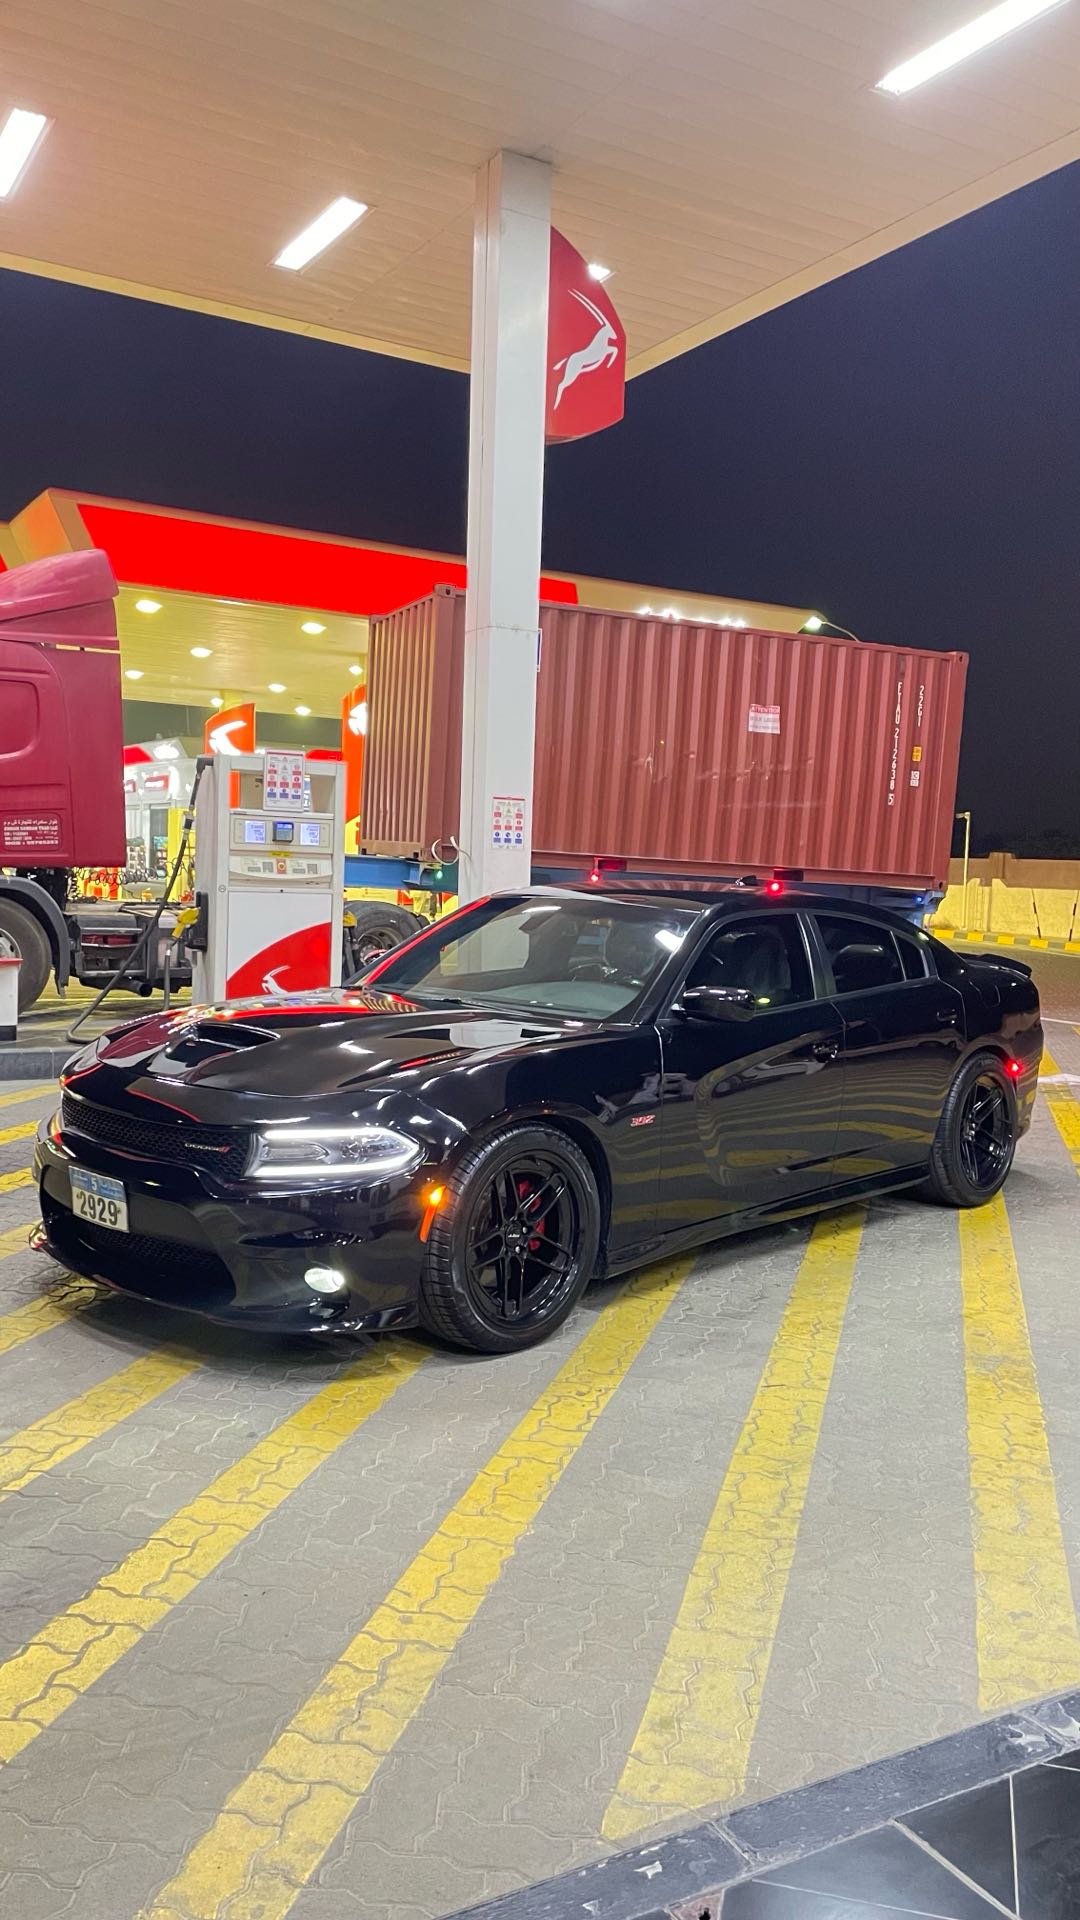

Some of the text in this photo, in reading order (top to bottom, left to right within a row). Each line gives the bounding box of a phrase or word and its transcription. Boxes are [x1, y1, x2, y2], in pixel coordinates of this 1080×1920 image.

[890, 728, 900, 790] 212638
[888, 793, 895, 806] 5
[91, 1177, 98, 1191] 5
[80, 1191, 118, 1226] 2929
